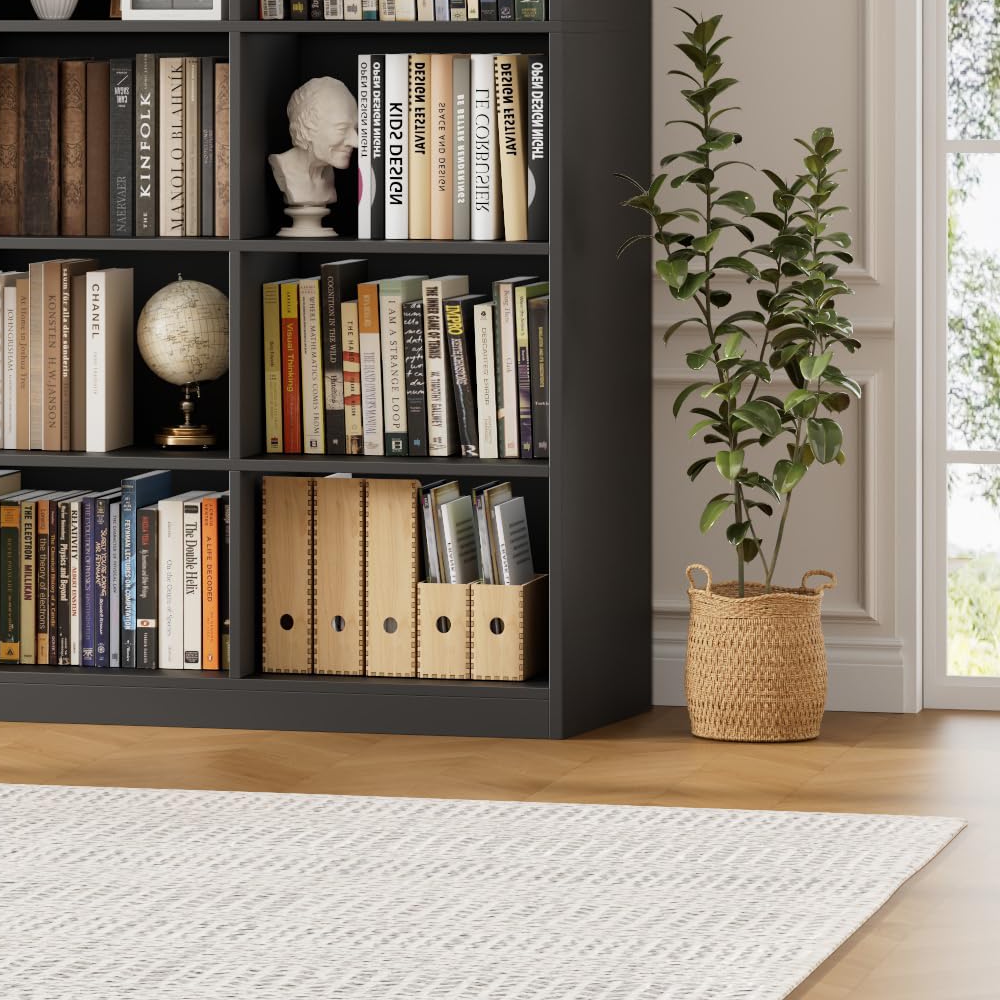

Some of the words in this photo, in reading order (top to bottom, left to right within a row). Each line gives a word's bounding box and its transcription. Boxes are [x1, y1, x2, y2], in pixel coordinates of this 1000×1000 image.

[140, 92, 151, 198] KINFOLK
[91, 283, 101, 340] CHANEL
[388, 308, 396, 326] AM
[445, 304, 463, 336] IMPRO
[286, 354, 294, 393] Thinking
[389, 340, 399, 393] STRANGE
[391, 397, 400, 430] LOOP
[24, 505, 33, 520] THE
[24, 522, 33, 560] ELECTRON
[185, 521, 198, 538] The
[185, 540, 199, 570] Double
[23, 564, 33, 601] MILLIKAN
[185, 572, 199, 595] Helix
